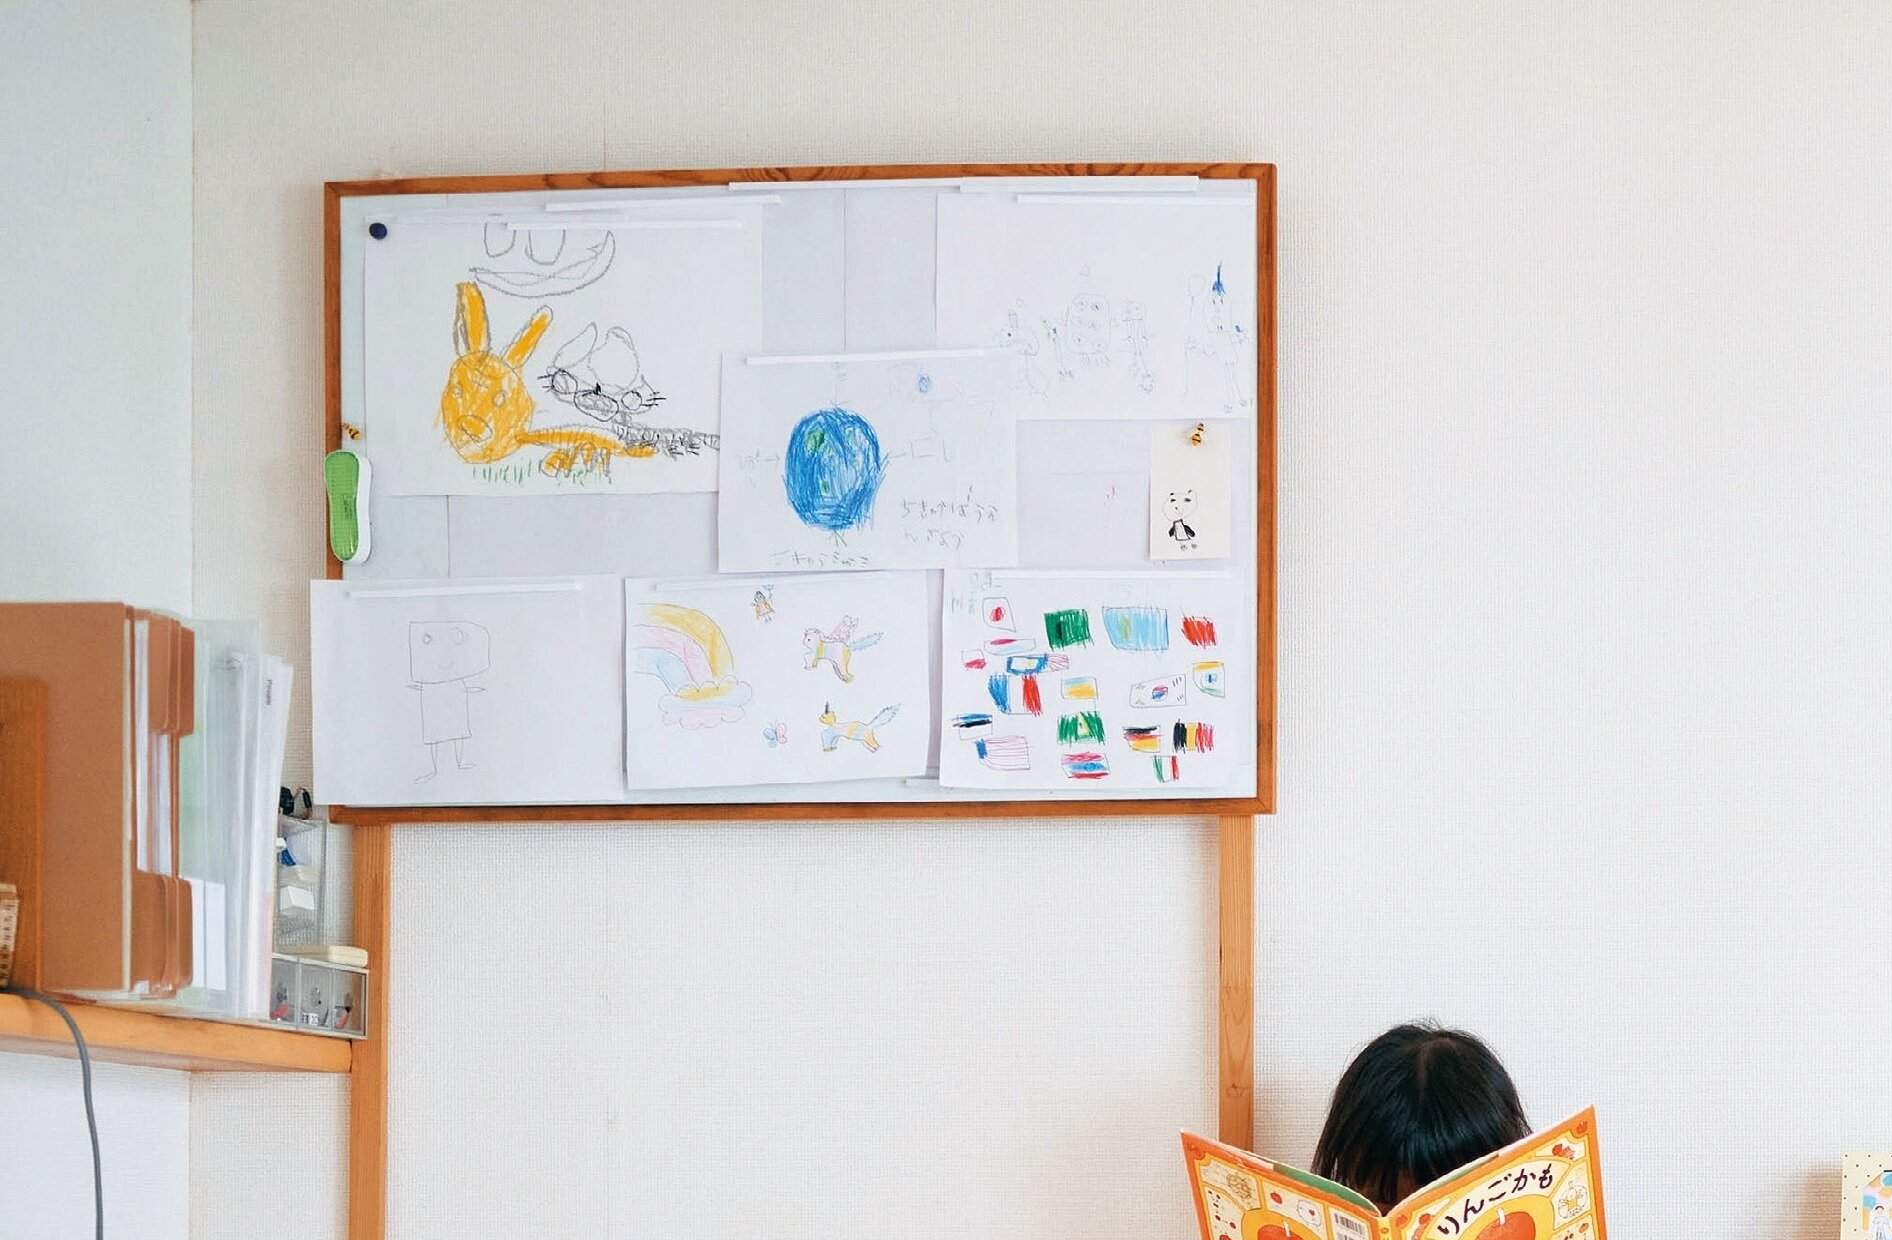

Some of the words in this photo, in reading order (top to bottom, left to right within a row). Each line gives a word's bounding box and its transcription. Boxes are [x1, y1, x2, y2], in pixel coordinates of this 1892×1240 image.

[1436, 1162, 1554, 1236] りんごかも
